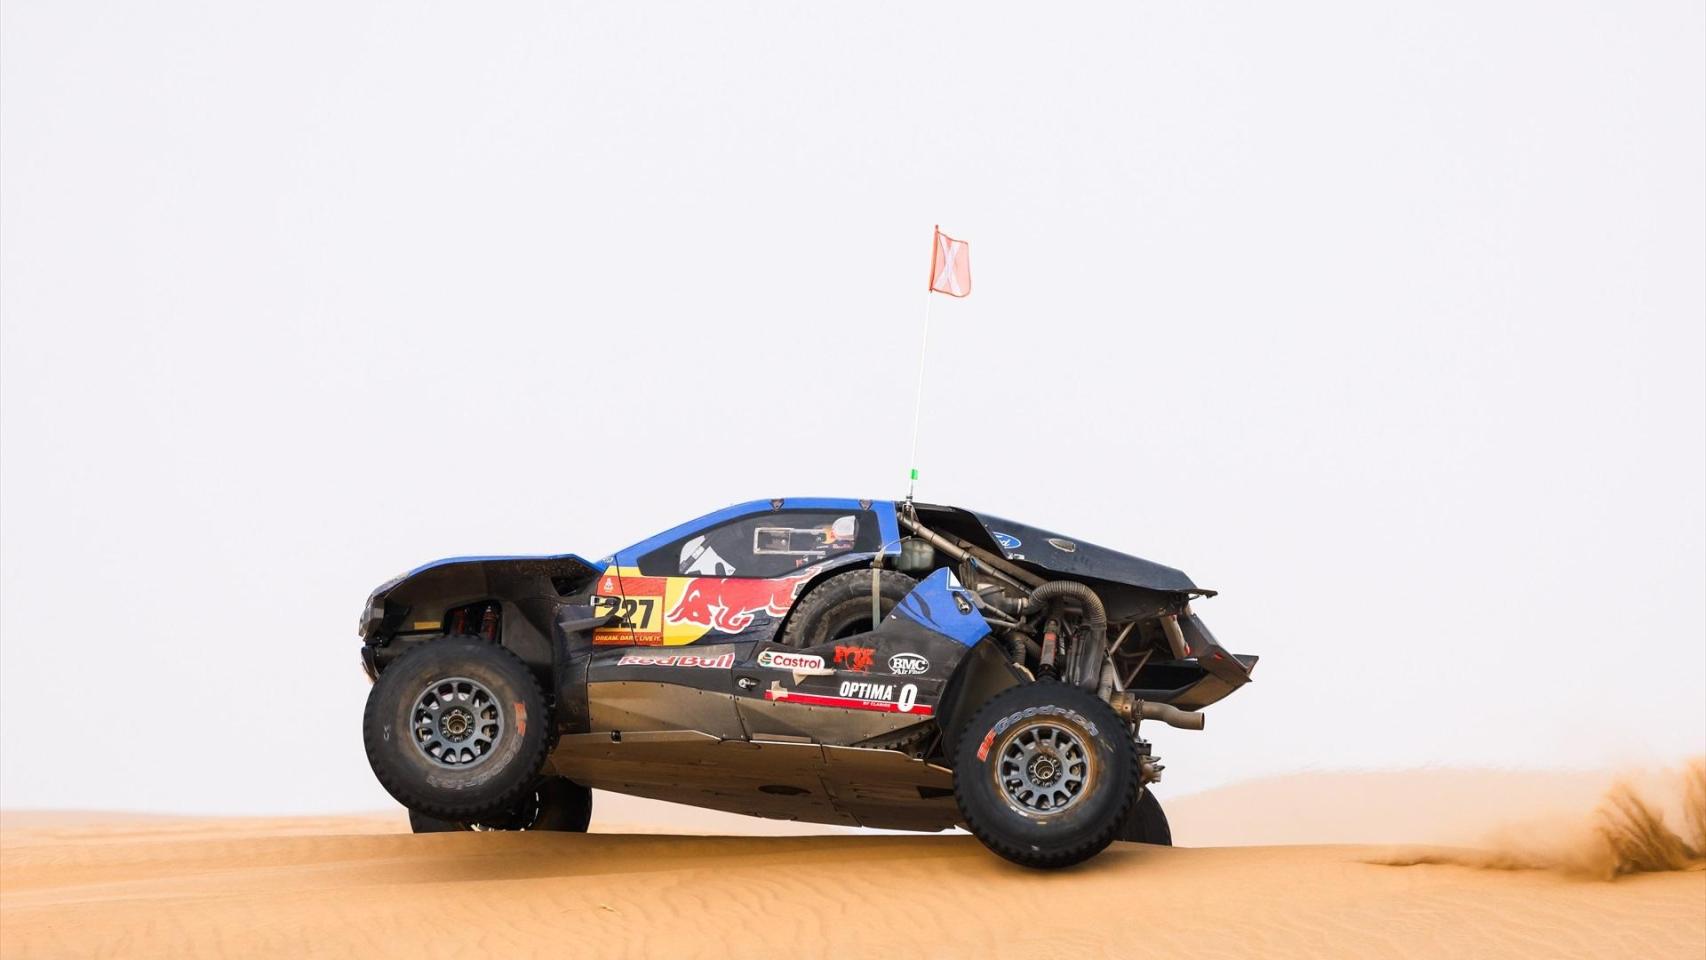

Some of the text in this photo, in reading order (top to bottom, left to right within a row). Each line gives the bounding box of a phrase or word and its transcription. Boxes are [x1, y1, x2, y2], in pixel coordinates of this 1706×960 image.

[618, 652, 735, 669] Red Bull
[773, 655, 822, 669] Castrol
[893, 658, 926, 671] BMC
[839, 681, 893, 701] OPTIMA
